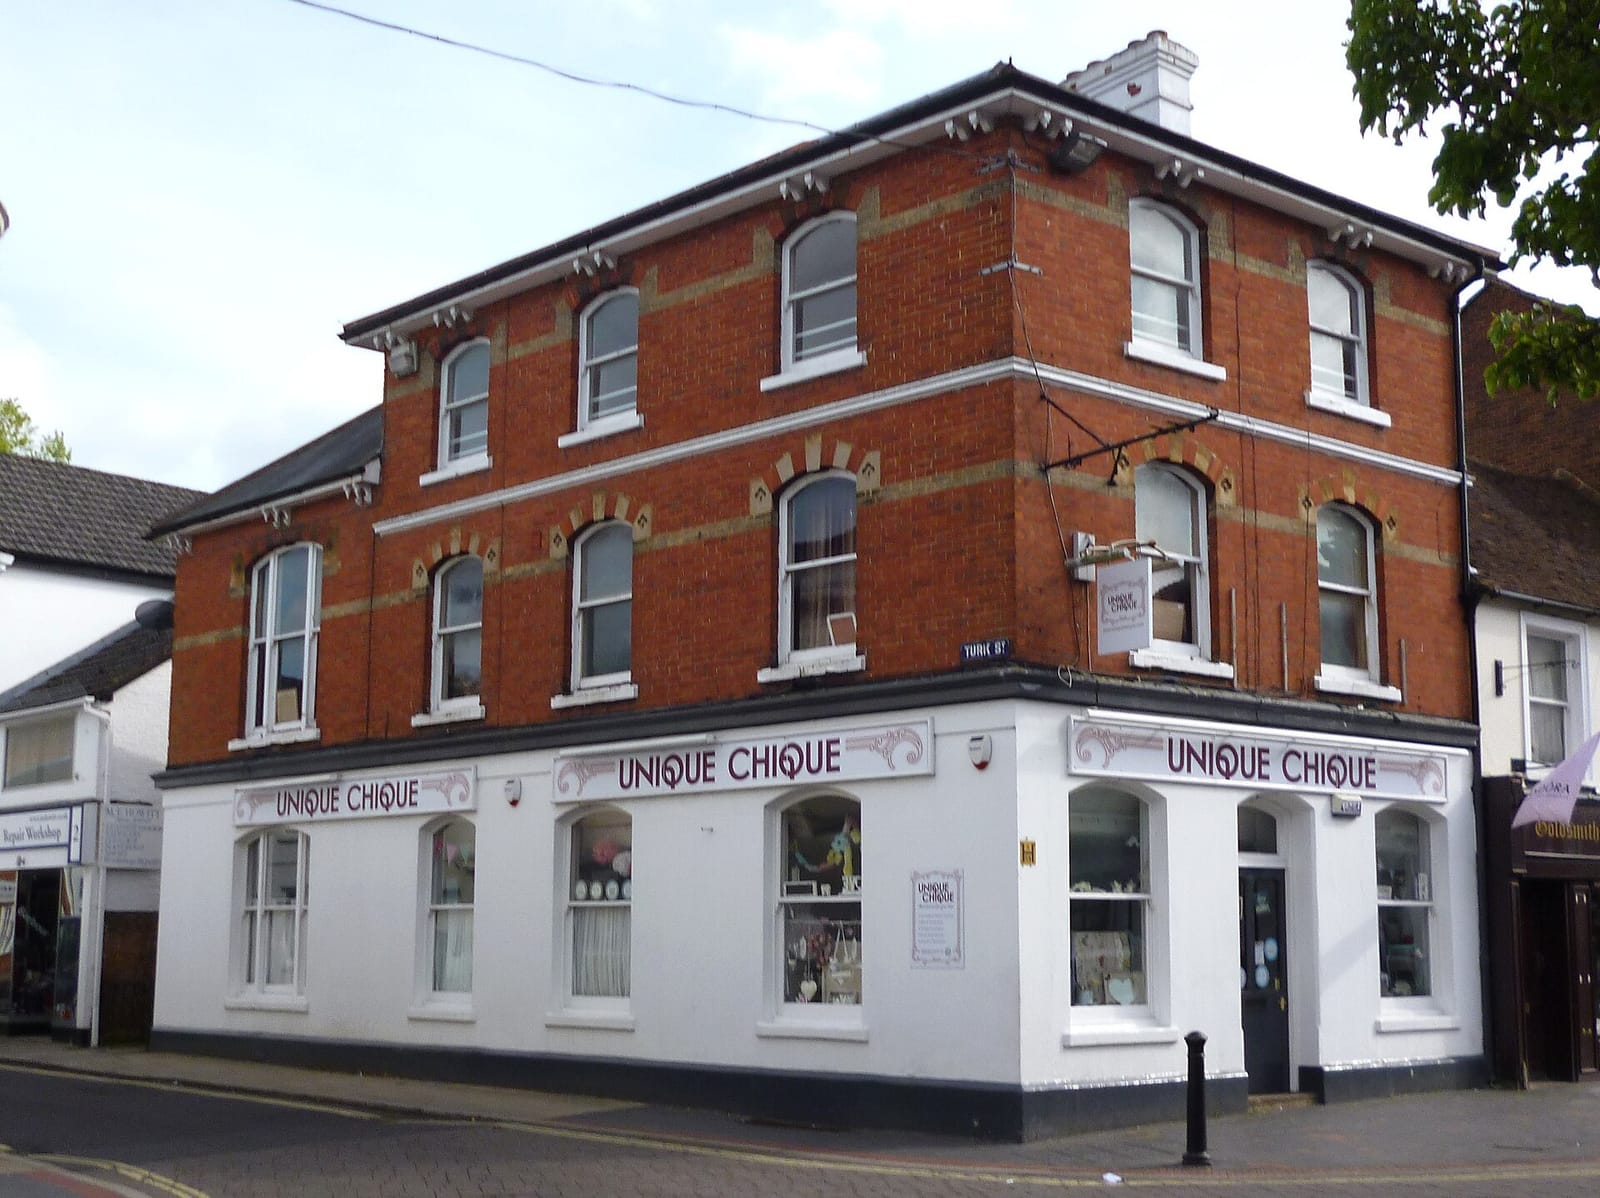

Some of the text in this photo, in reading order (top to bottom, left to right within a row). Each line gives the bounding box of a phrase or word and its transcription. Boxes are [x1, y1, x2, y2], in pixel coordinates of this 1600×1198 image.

[1107, 592, 1133, 605] UNIQUE
[1111, 600, 1137, 612] CHIQUE
[963, 642, 991, 659] TURK
[618, 738, 841, 789] UNIQUE CHIQUE
[1167, 737, 1377, 789] UNIQUE CHIQUE
[276, 780, 419, 818] UNIQUE CHIQUE
[3, 824, 61, 846] Repair Workshop
[918, 881, 950, 893] UNIQUE
[922, 890, 953, 903] CHIQUE
